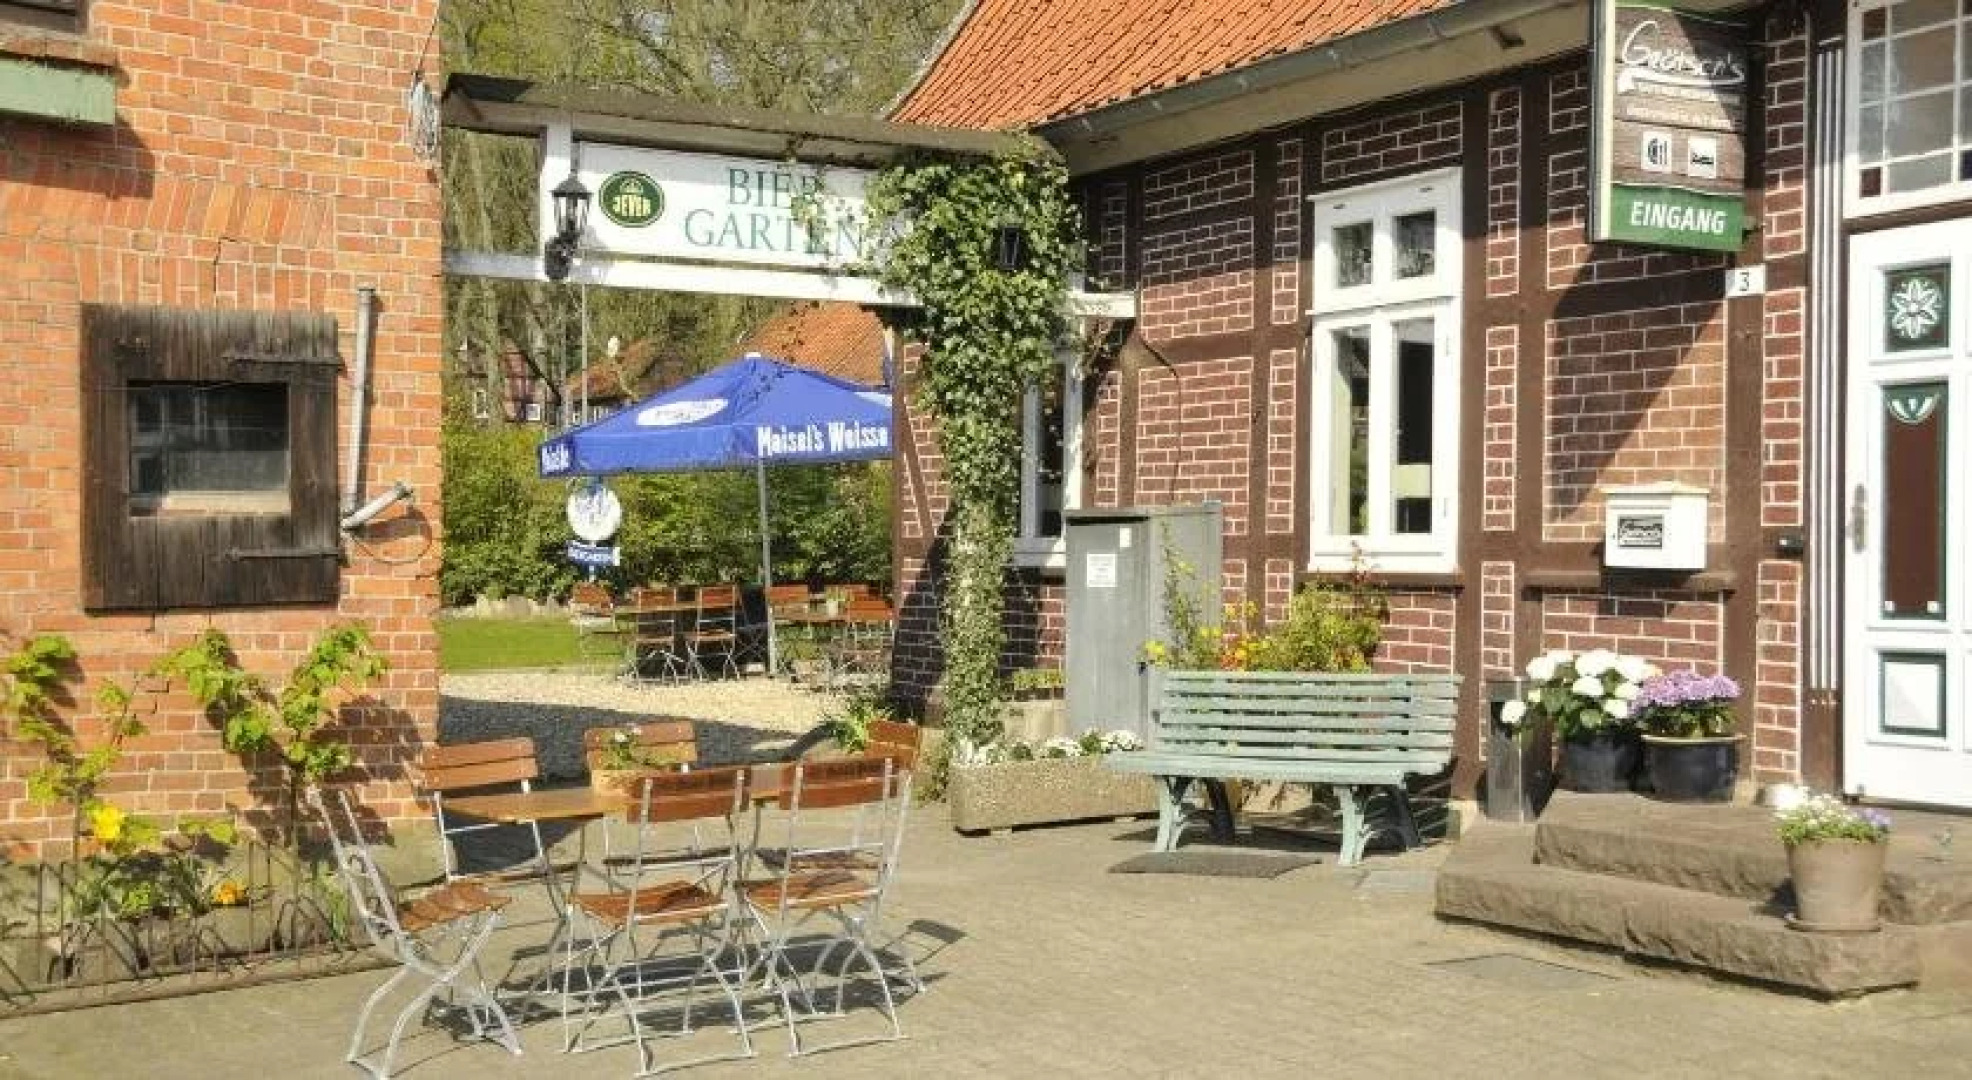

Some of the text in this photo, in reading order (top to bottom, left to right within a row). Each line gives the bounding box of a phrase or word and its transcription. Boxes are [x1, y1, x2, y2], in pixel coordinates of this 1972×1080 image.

[612, 194, 651, 217] JEVER
[728, 168, 823, 209] BIER
[684, 208, 864, 257] GARTEN
[1630, 200, 1728, 235] EINGANG
[1739, 271, 1750, 292] 3
[757, 420, 889, 457] Maisel's Weisse
